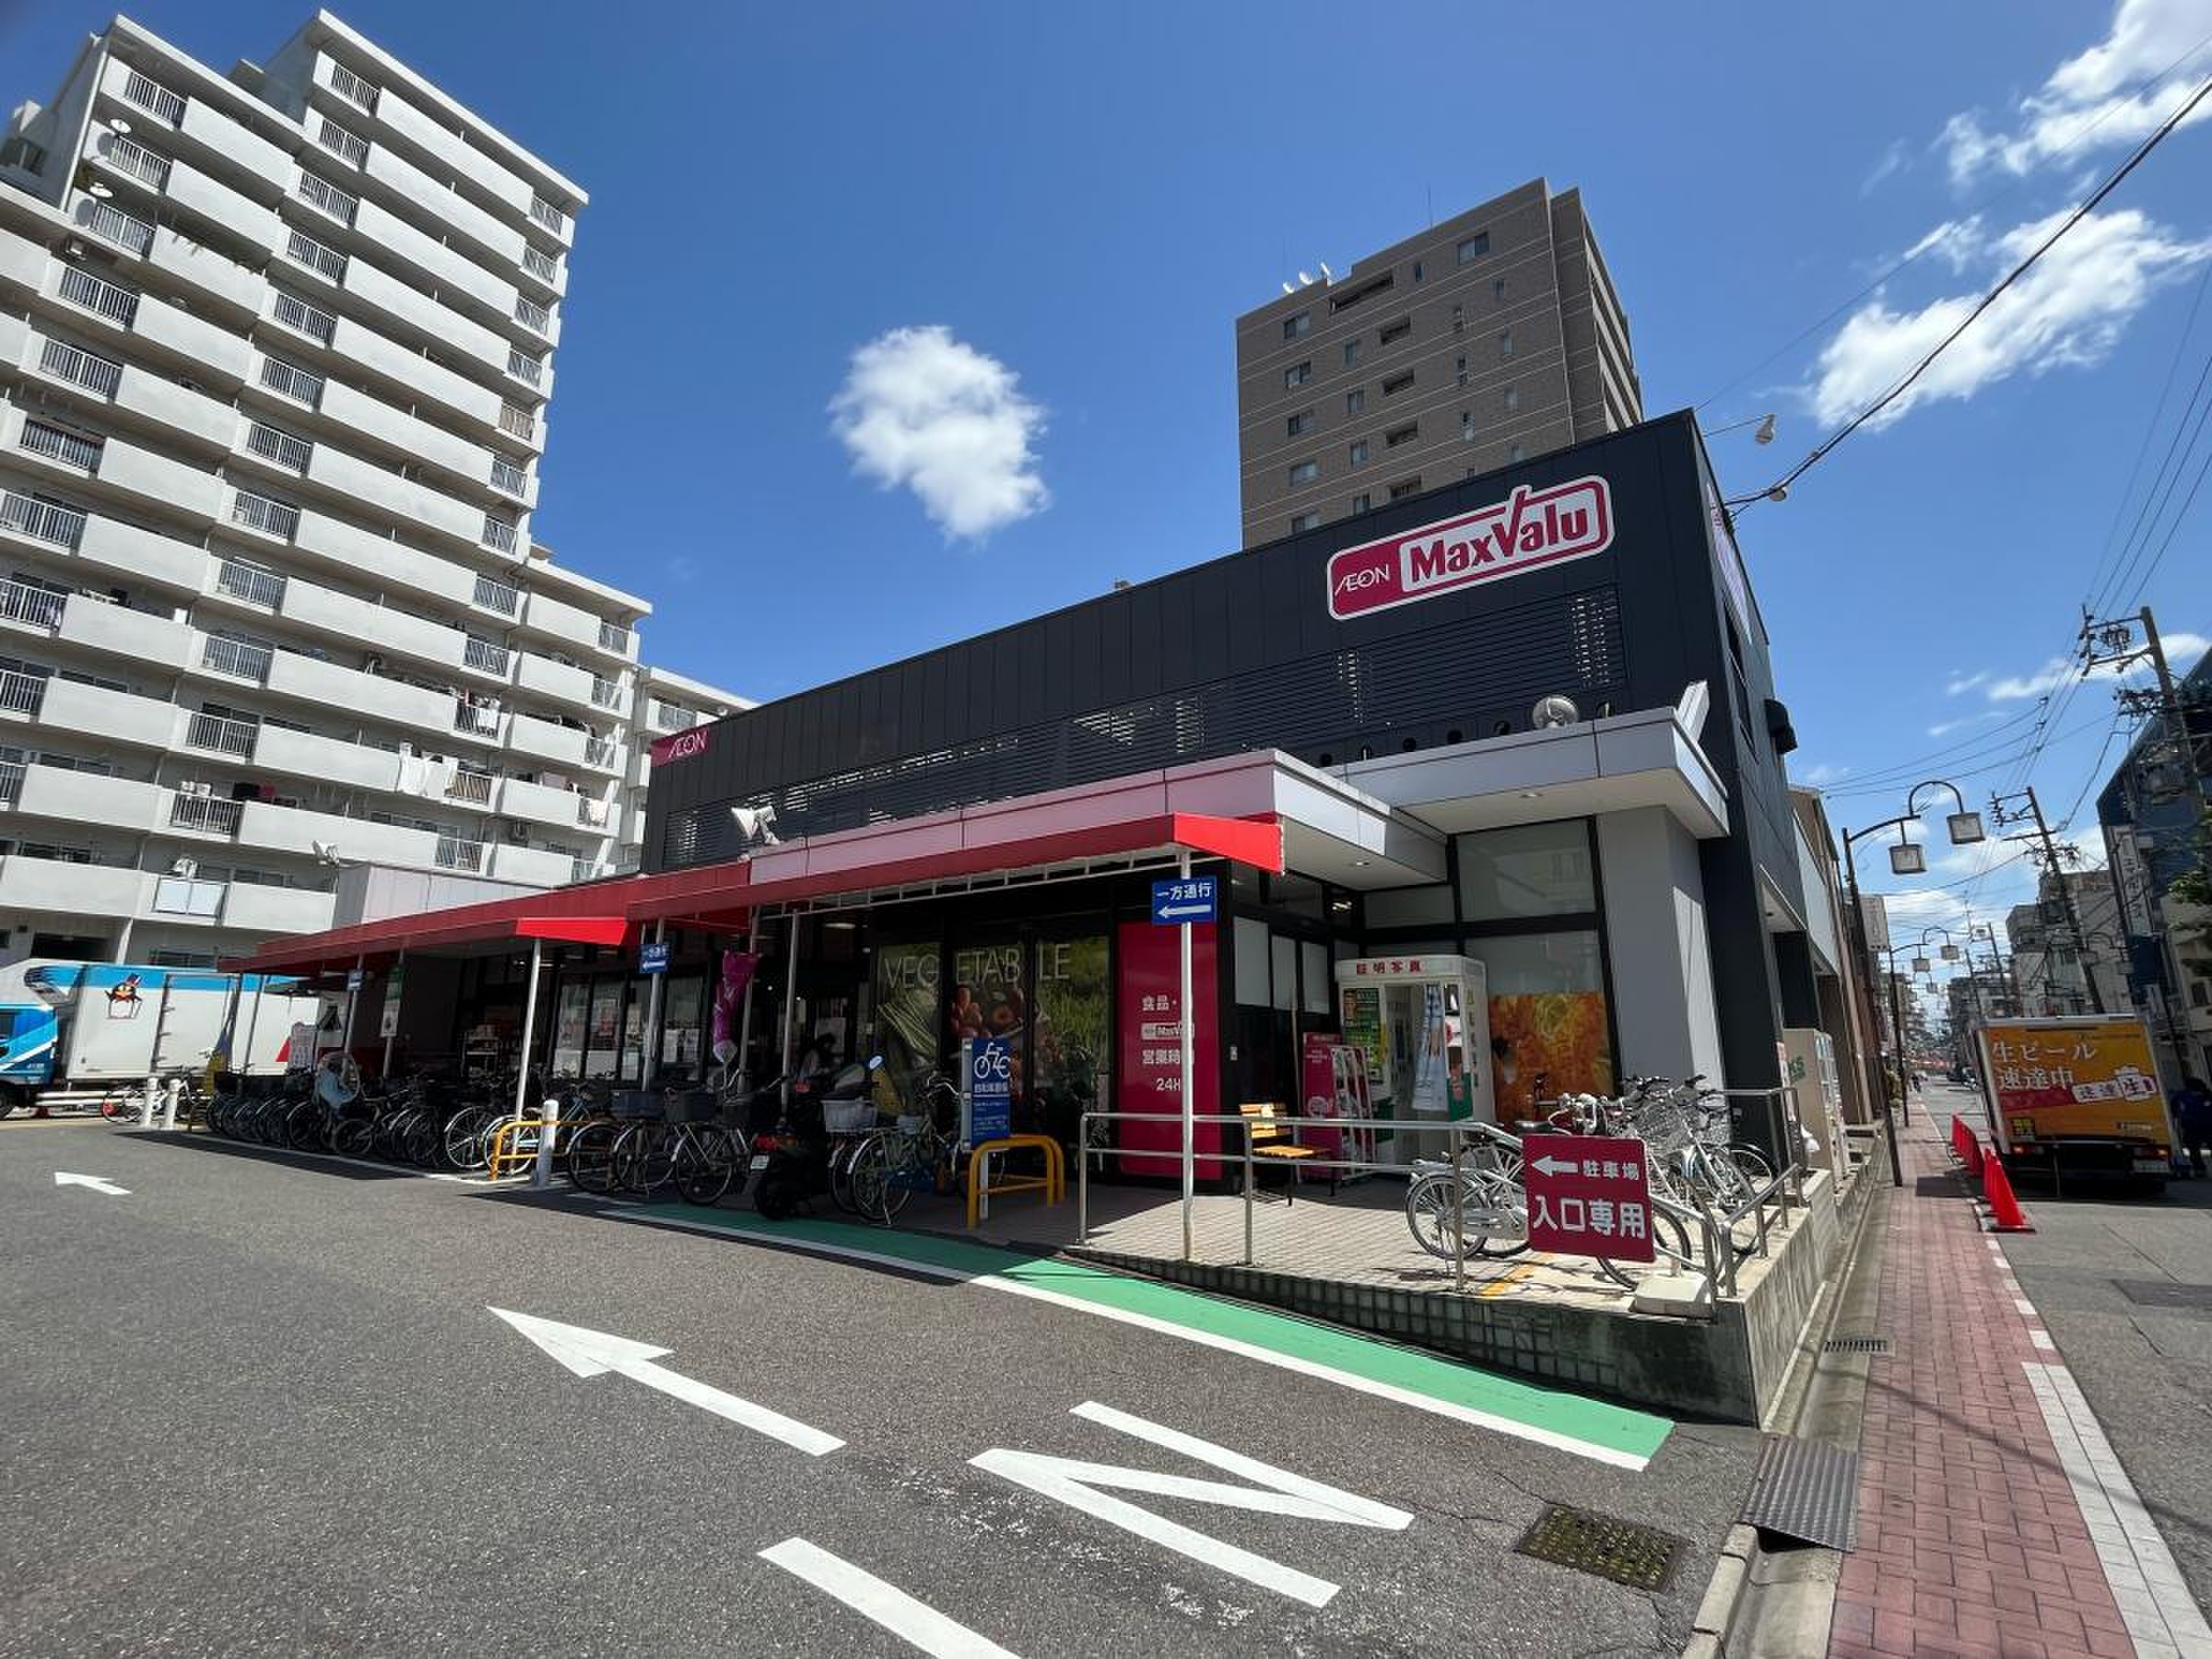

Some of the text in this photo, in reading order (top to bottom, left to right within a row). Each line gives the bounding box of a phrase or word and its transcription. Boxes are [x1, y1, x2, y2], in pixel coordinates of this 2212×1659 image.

[1409, 489, 1588, 582] MaxValu
[1156, 882, 1213, 900] 一方通行
[1142, 994, 1183, 1011] 食品・
[1142, 1048, 1194, 1065] 営業時
[1992, 1041, 2097, 1063] 生ビール
[1583, 1159, 1640, 1181] 駐車場
[1533, 1194, 1646, 1239] 入口専用
